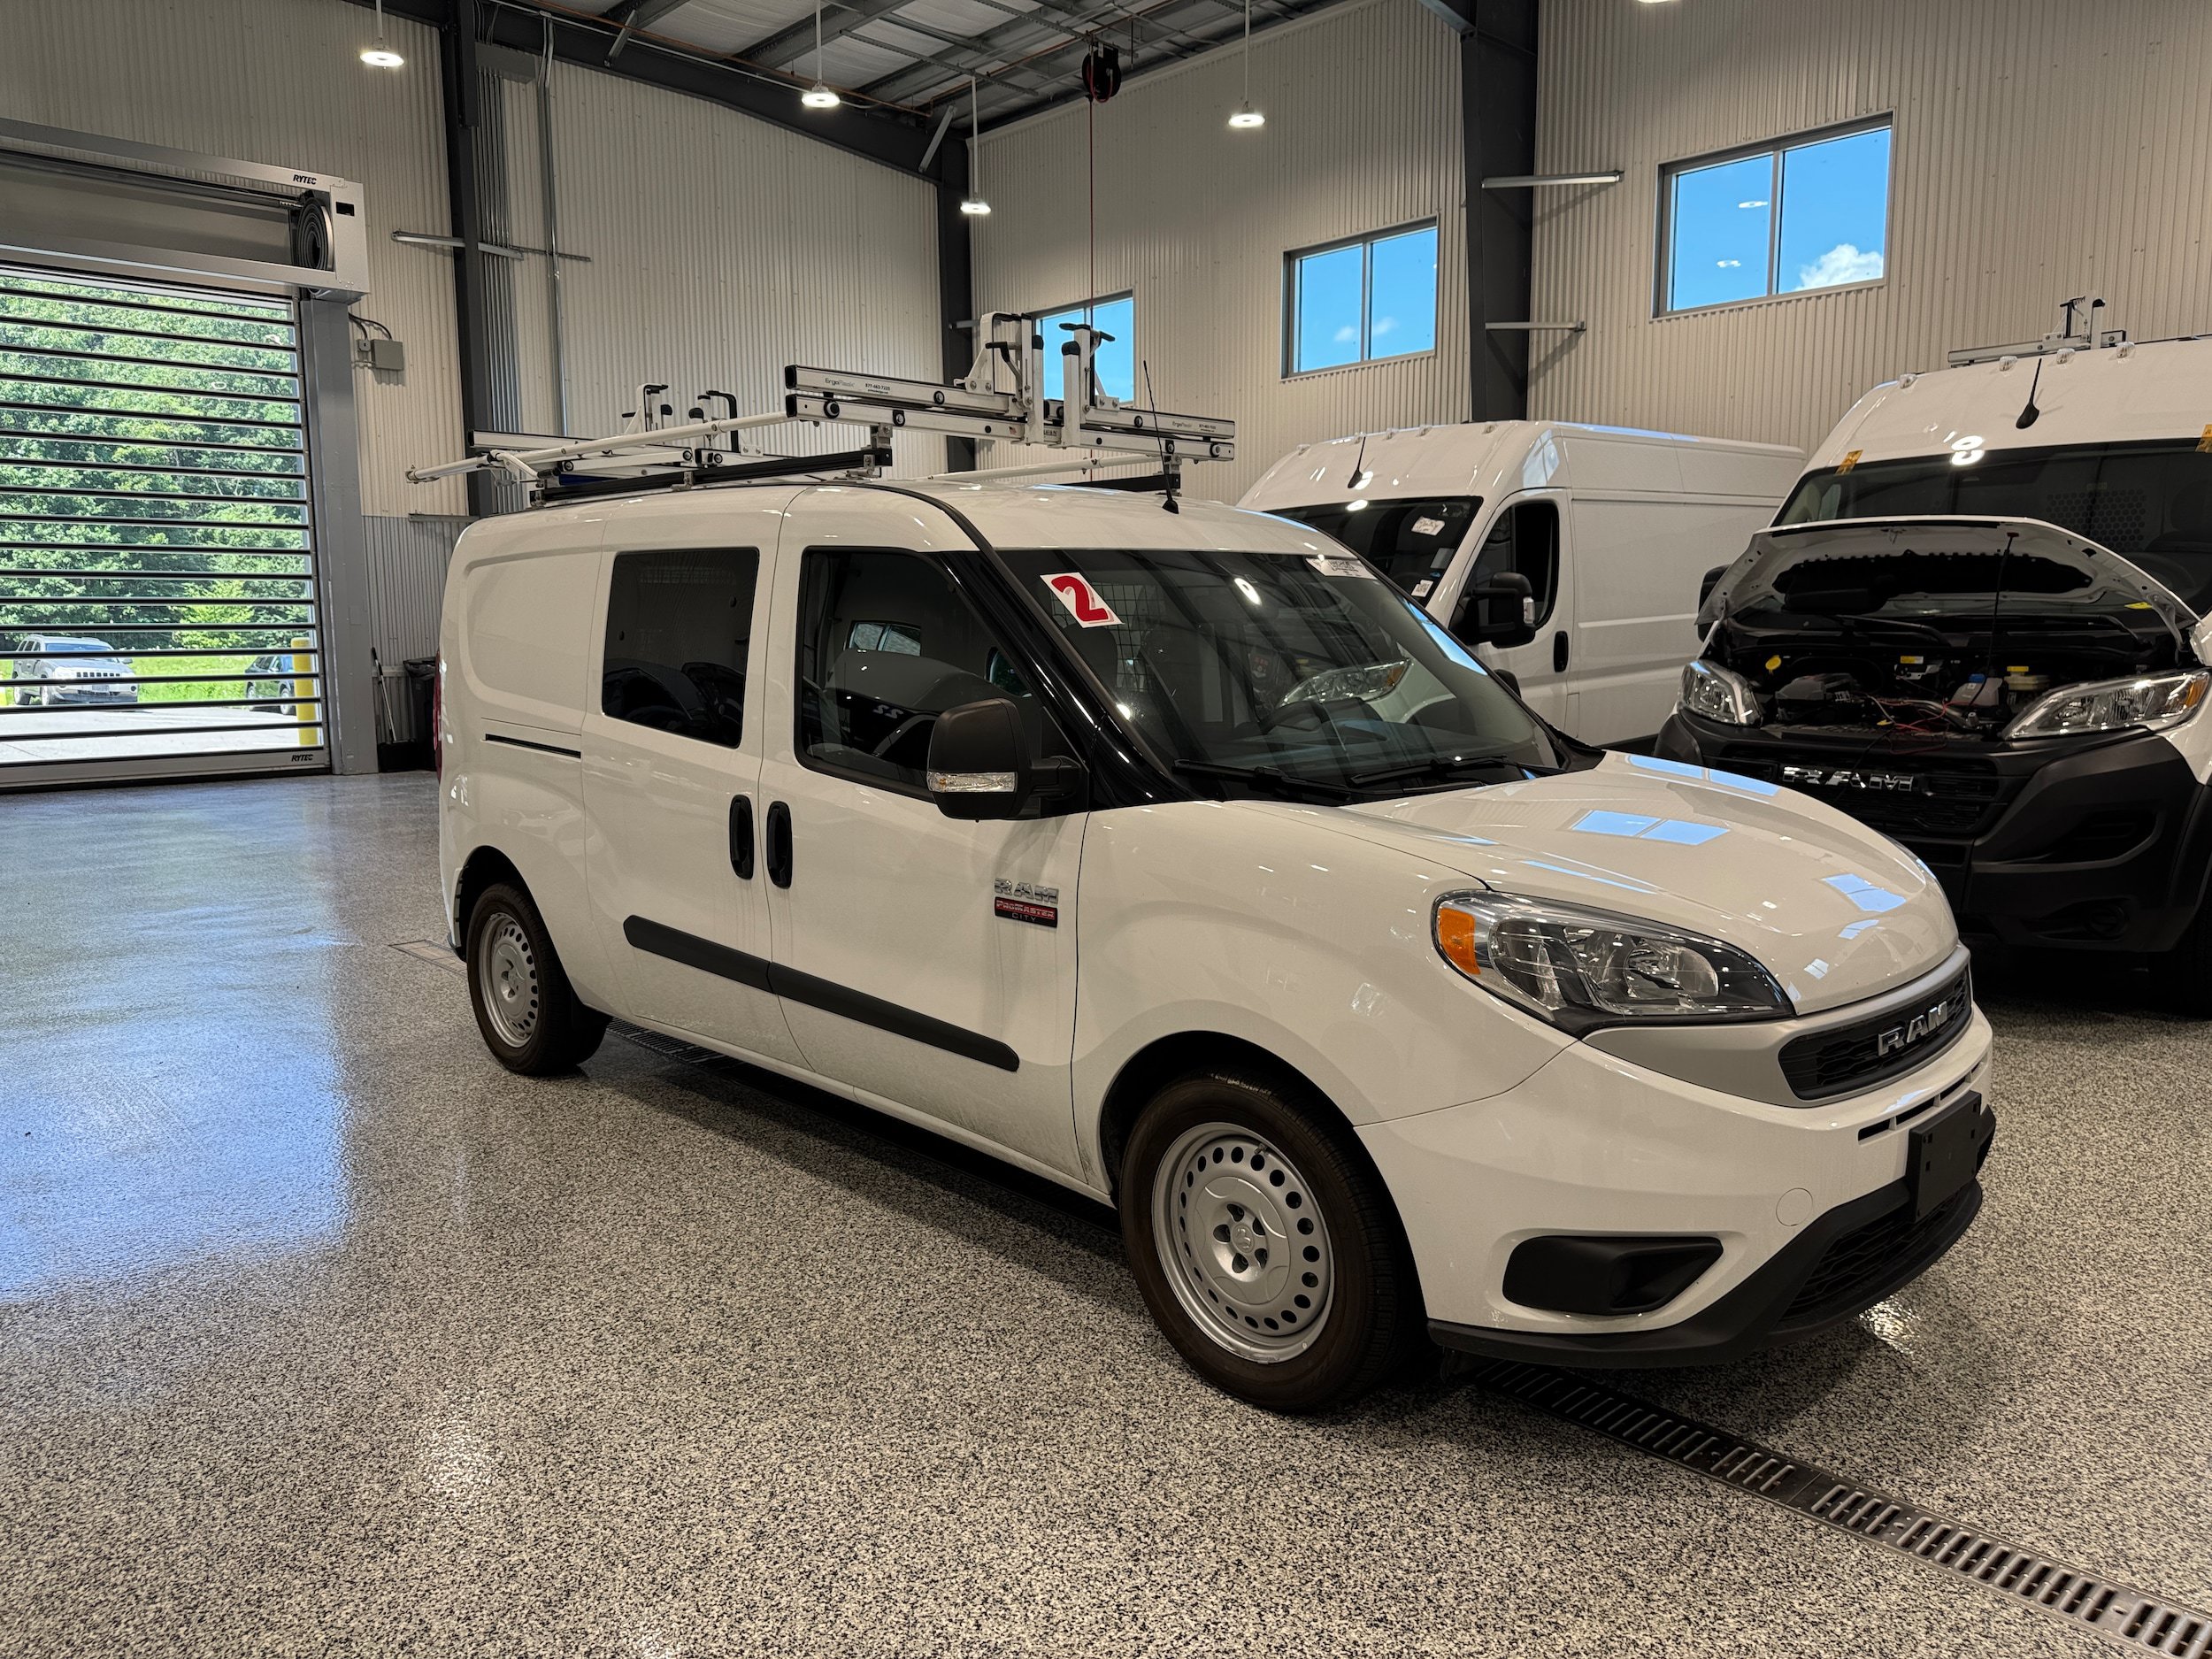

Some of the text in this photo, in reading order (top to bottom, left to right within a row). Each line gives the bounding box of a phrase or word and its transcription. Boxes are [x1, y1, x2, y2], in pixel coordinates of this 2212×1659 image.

[292, 173, 318, 185] RYTEC
[1050, 575, 1112, 623] 2
[1782, 765, 1915, 792] RAM
[994, 878, 1059, 904] RAM
[1011, 912, 1036, 922] CITY
[1878, 1000, 1948, 1056] RAM
